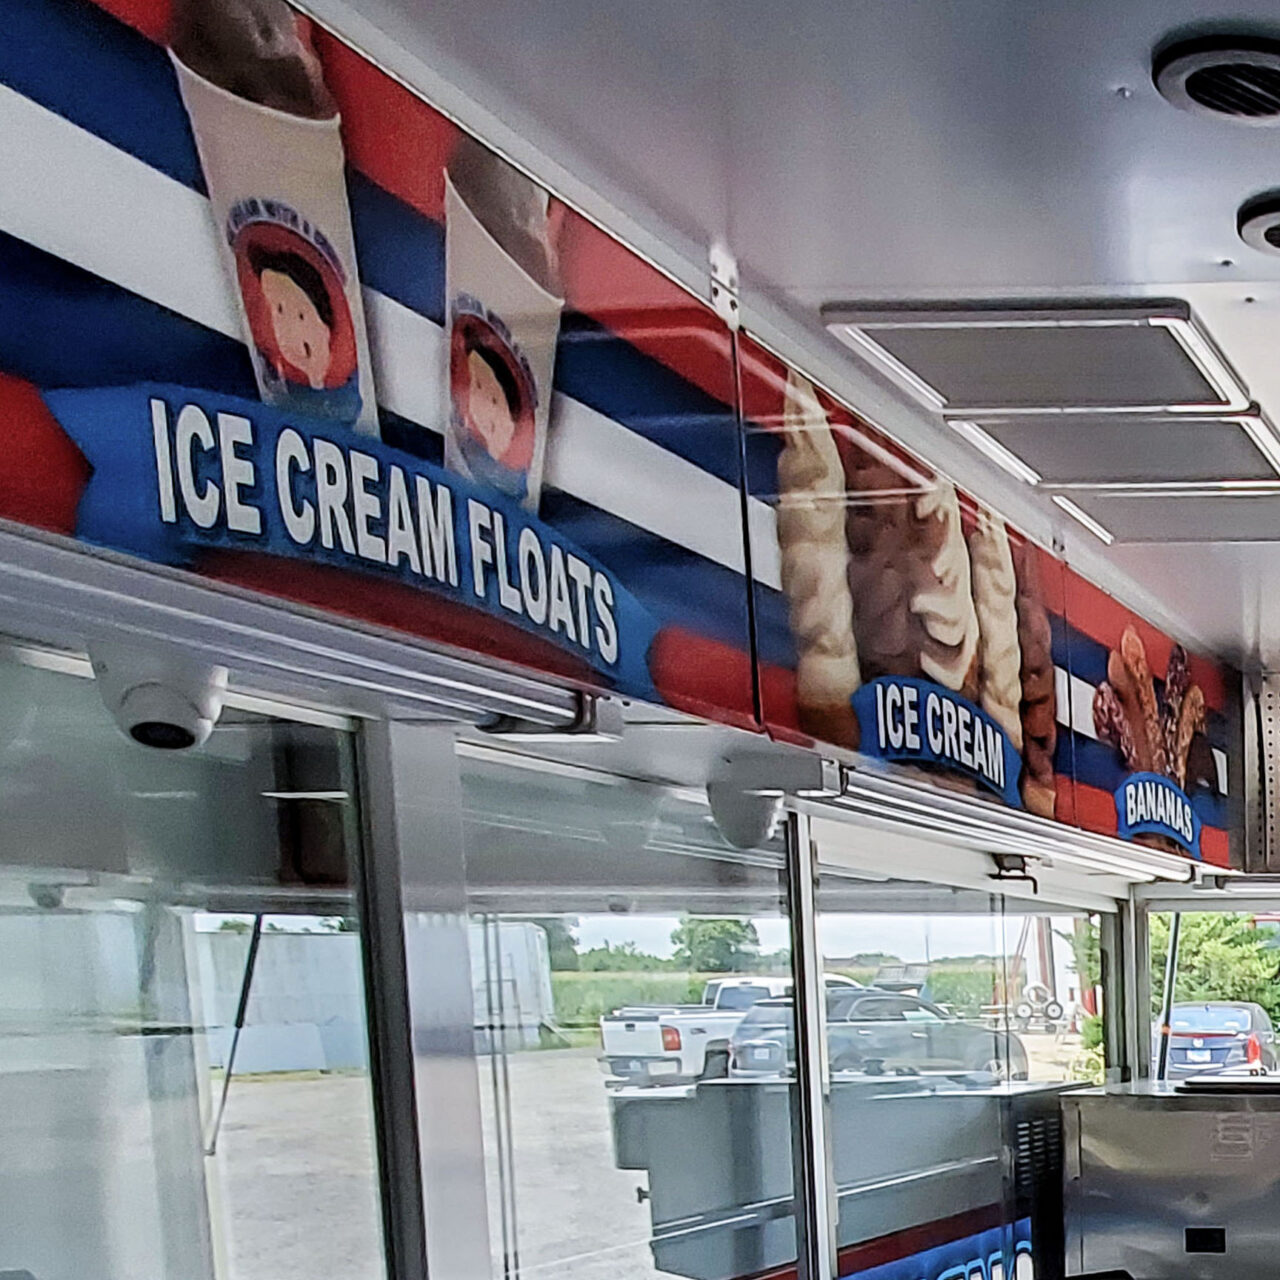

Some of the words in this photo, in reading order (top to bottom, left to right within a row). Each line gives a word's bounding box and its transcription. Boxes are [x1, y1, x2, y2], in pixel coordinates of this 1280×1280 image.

[150, 398, 262, 535] ICE
[275, 428, 460, 588] CREAM
[468, 498, 619, 665] FLOATS
[875, 683, 921, 750] ICE
[926, 692, 1005, 790] CREAM
[1125, 781, 1194, 843] BANANAS
